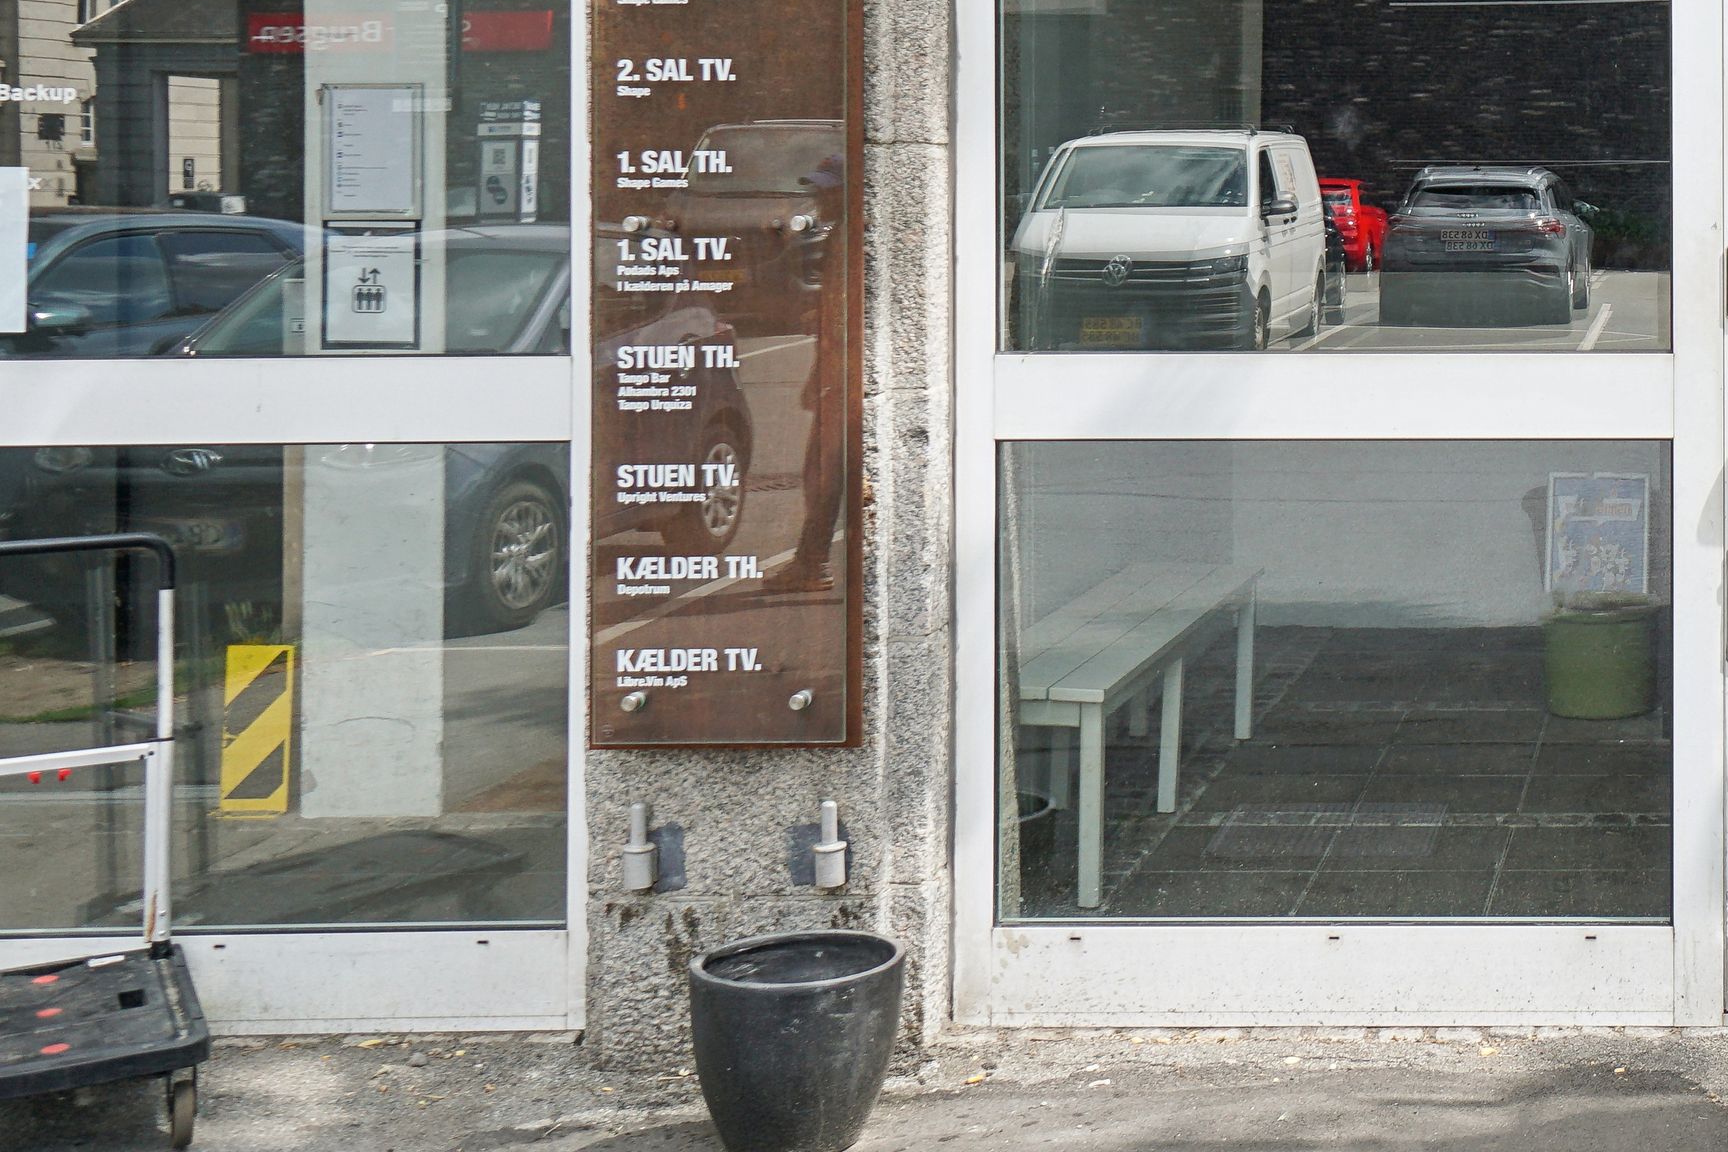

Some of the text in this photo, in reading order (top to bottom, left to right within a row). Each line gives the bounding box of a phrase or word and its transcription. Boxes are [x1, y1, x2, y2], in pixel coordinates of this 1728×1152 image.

[617, 59, 736, 81] 2. SAL TV.
[0, 83, 77, 104] Backup
[617, 86, 650, 97] Shape
[617, 151, 732, 174] 1. SAL TH.
[617, 176, 688, 189] Shape Games
[617, 238, 731, 261] 1. SAL TV.
[617, 280, 733, 293] I kælderen på Amager
[617, 344, 740, 369] STUEN TH.
[618, 373, 671, 385] Tango Bar
[618, 386, 696, 396] Alhambra 2301
[618, 400, 649, 411] Tango
[618, 464, 739, 488] STUEN TV.
[617, 492, 708, 504] Upright Ventures
[617, 556, 764, 580] KÆLDER TH.
[617, 584, 670, 596] Depotrum
[617, 648, 761, 672] KÆLDER TV.
